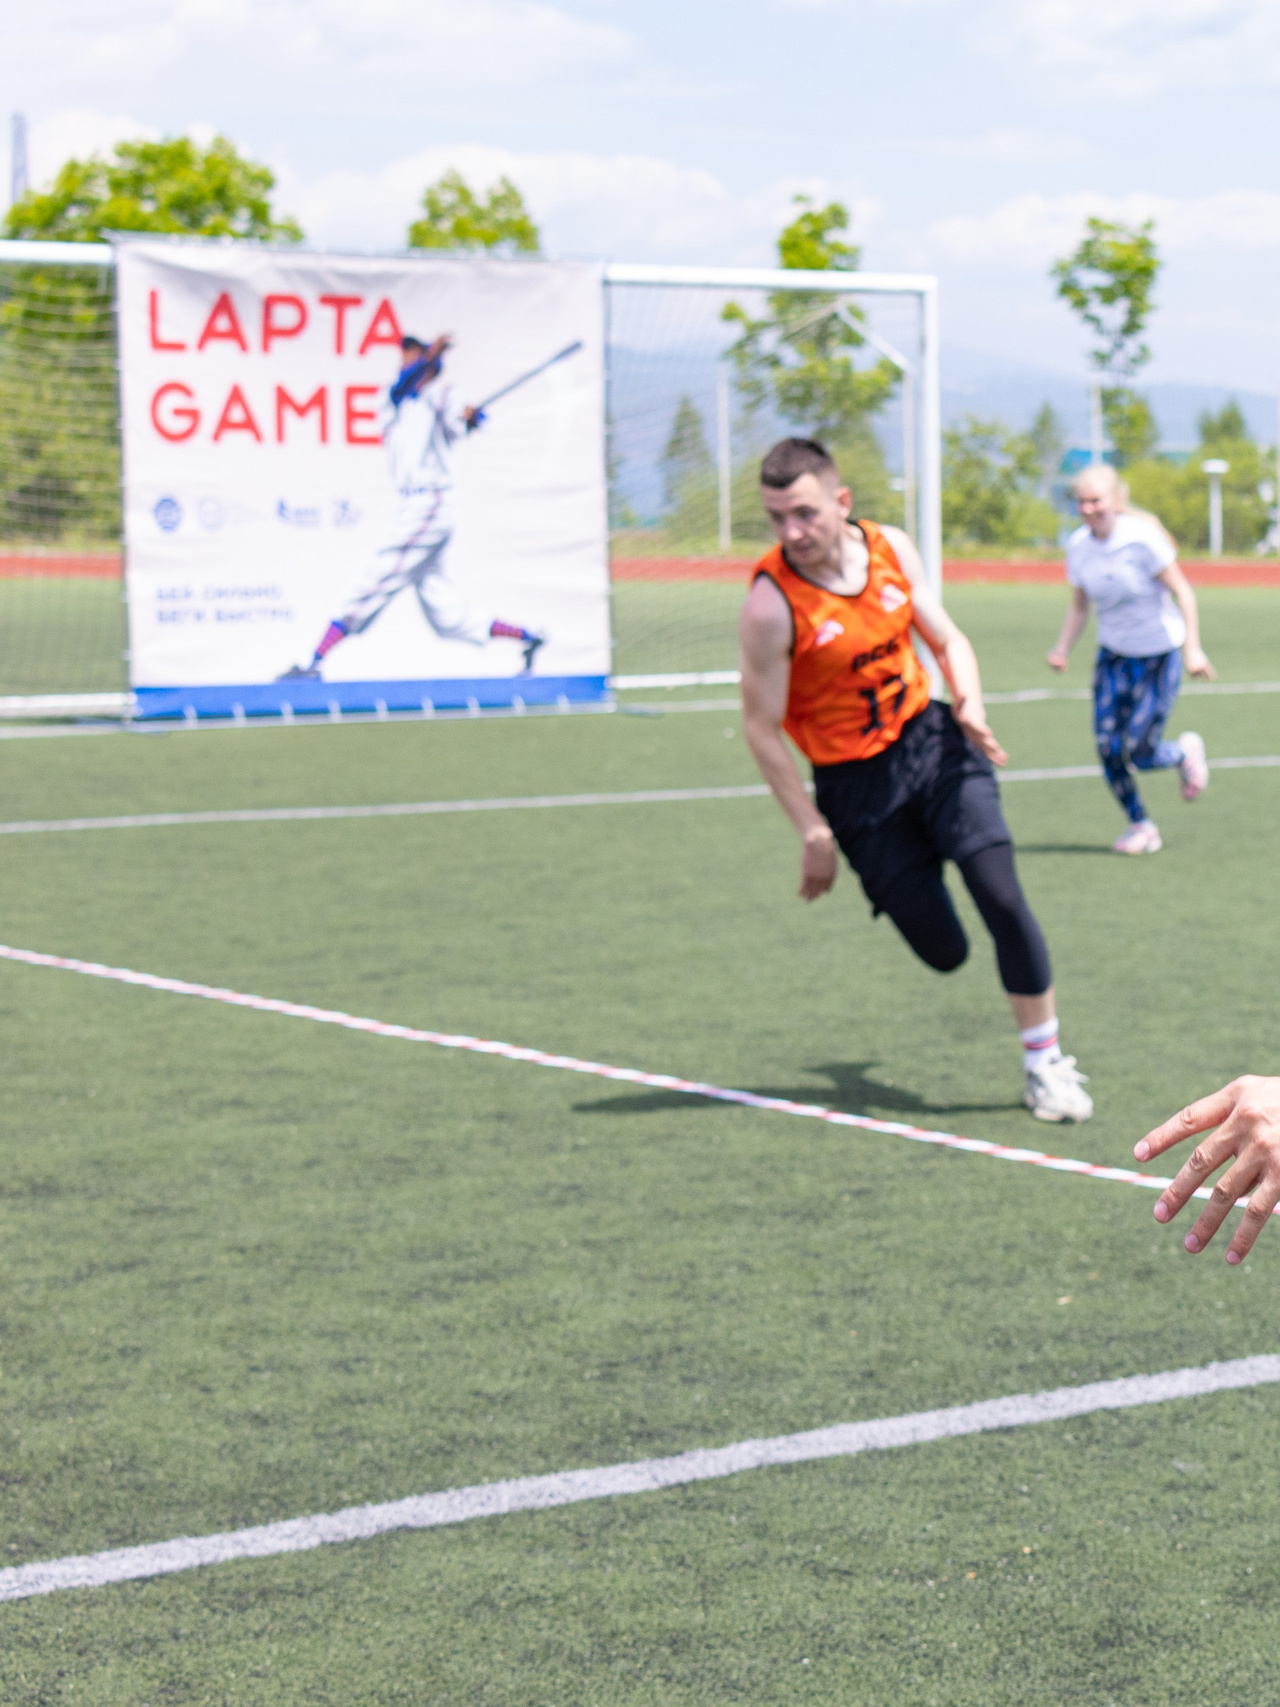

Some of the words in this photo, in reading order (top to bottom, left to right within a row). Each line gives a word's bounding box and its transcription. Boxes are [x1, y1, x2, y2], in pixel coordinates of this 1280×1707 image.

[149, 290, 404, 356] LAPTA
[150, 382, 384, 445] GAME
[859, 672, 907, 735] 17
